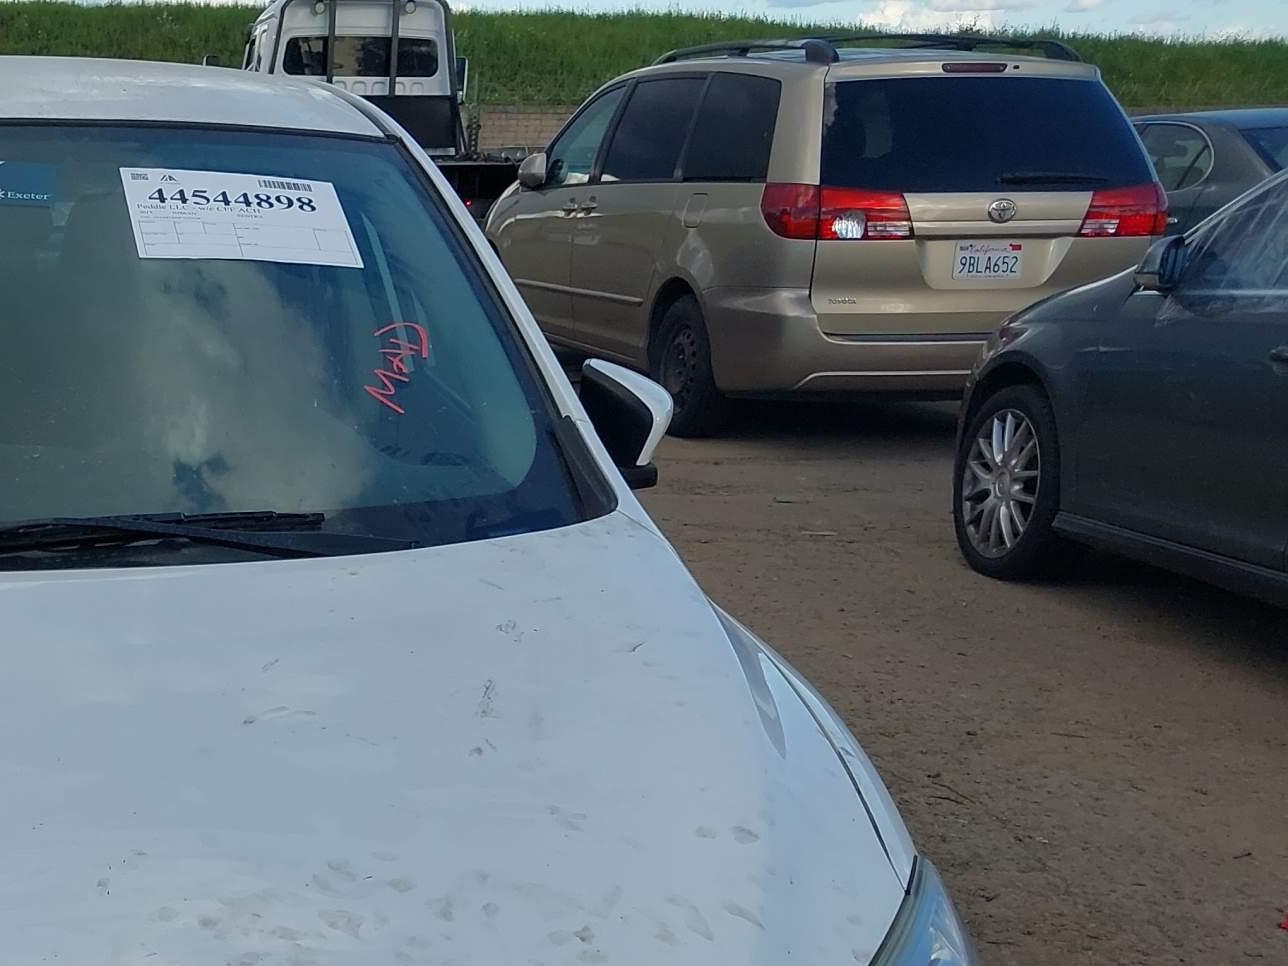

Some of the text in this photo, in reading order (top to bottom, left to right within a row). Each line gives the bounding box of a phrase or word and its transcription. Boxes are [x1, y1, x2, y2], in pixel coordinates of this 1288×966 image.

[7, 191, 49, 200] Exeter
[148, 187, 317, 213] 44544898
[958, 255, 1019, 274] 9BLA652
